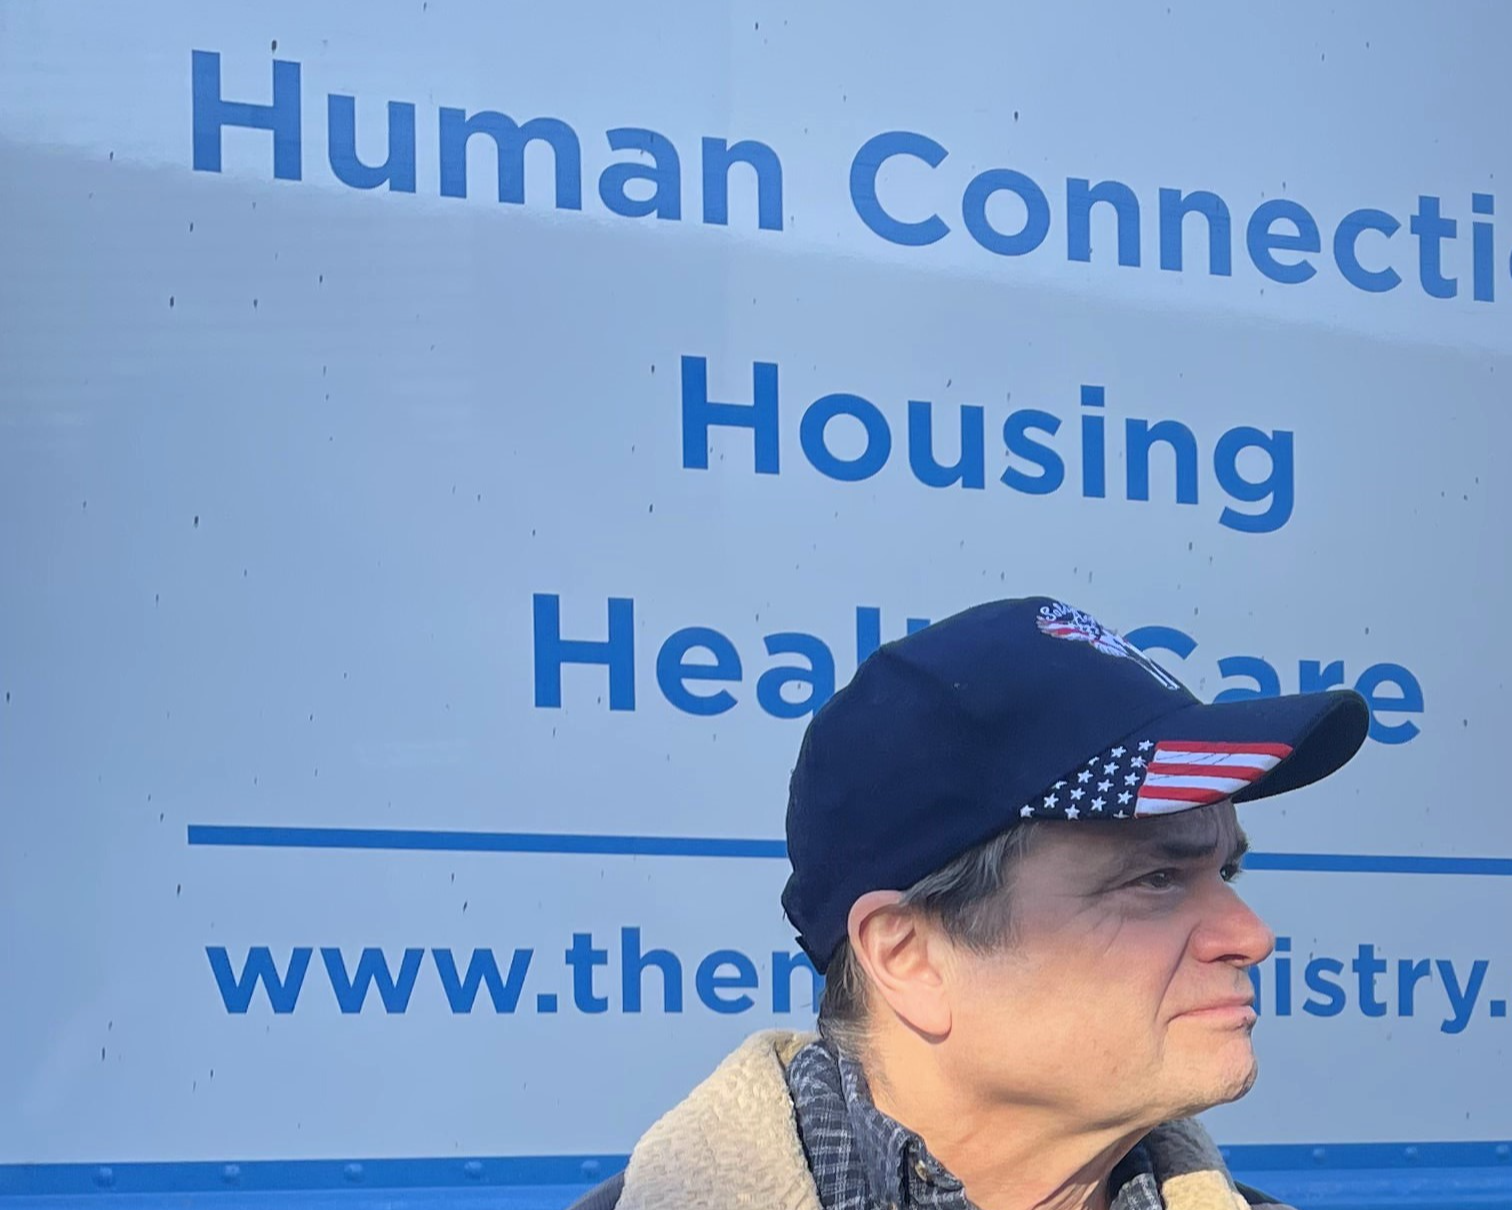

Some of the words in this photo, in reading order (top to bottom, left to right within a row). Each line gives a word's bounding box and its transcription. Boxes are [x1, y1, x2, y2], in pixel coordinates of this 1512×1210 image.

[193, 51, 783, 231] Human
[681, 355, 1294, 533] Housing
[532, 593, 931, 719] Hea
